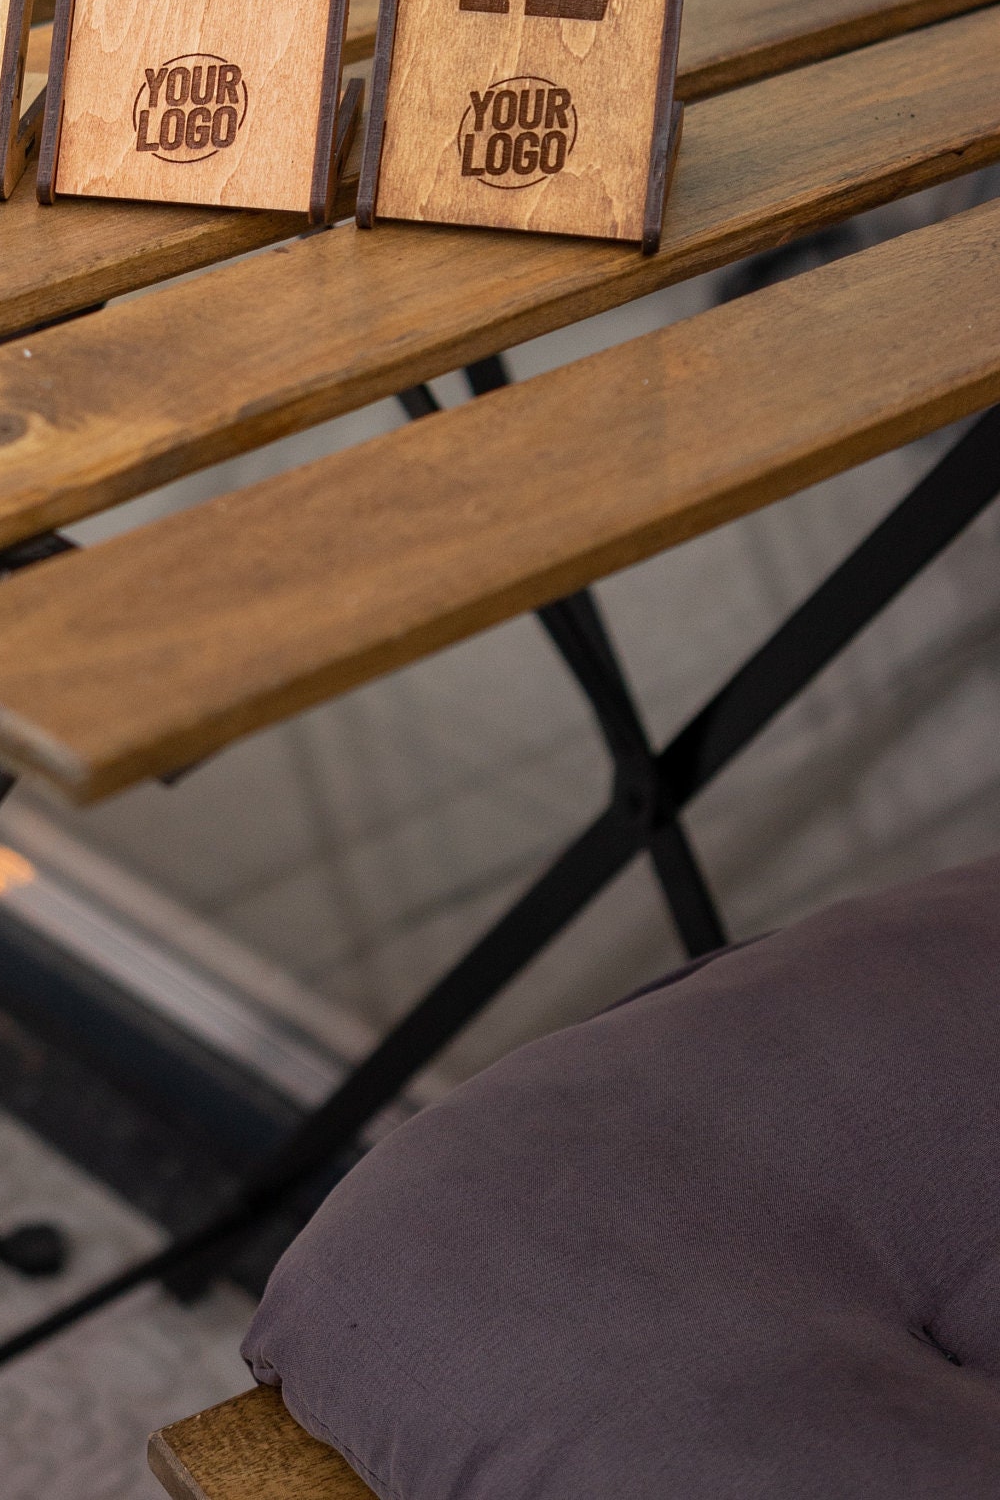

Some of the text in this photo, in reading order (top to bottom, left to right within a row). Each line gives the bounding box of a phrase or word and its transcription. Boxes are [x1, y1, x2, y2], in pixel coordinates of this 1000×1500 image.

[143, 63, 242, 107] YOUR
[135, 105, 237, 152] LOGO
[469, 87, 571, 132] YOUR
[460, 129, 566, 177] LOGO
